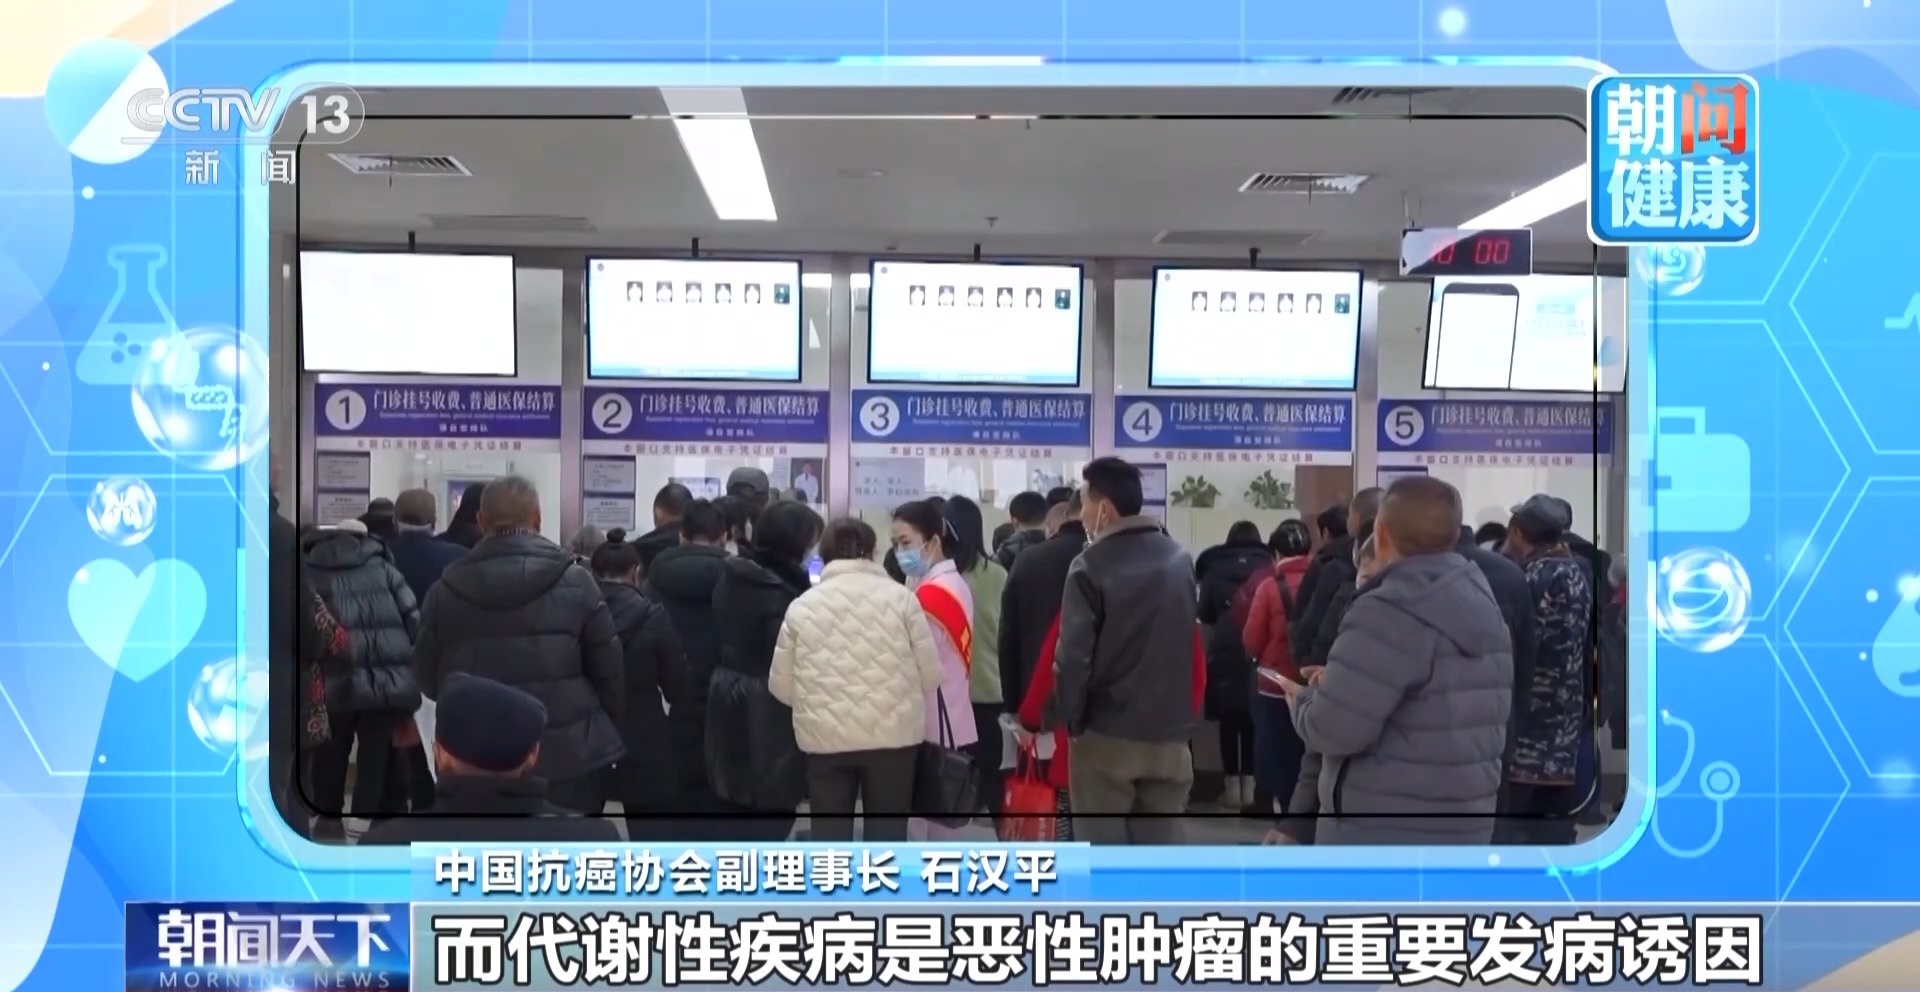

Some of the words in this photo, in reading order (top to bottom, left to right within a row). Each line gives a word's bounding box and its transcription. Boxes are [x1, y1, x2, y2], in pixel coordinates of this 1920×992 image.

[339, 395, 351, 424] 1
[373, 389, 556, 412] 门诊挂号收费、普通医保结算
[602, 398, 622, 428] 2
[639, 393, 820, 416] 门诊挂号收费、普通医保结算
[870, 402, 889, 431] 3
[907, 396, 1086, 419] 门诊挂号收费、普通医保结算
[1132, 408, 1153, 436] 4
[1169, 402, 1346, 425] 门诊挂号收费、普通医保结算
[1395, 410, 1415, 439] 5
